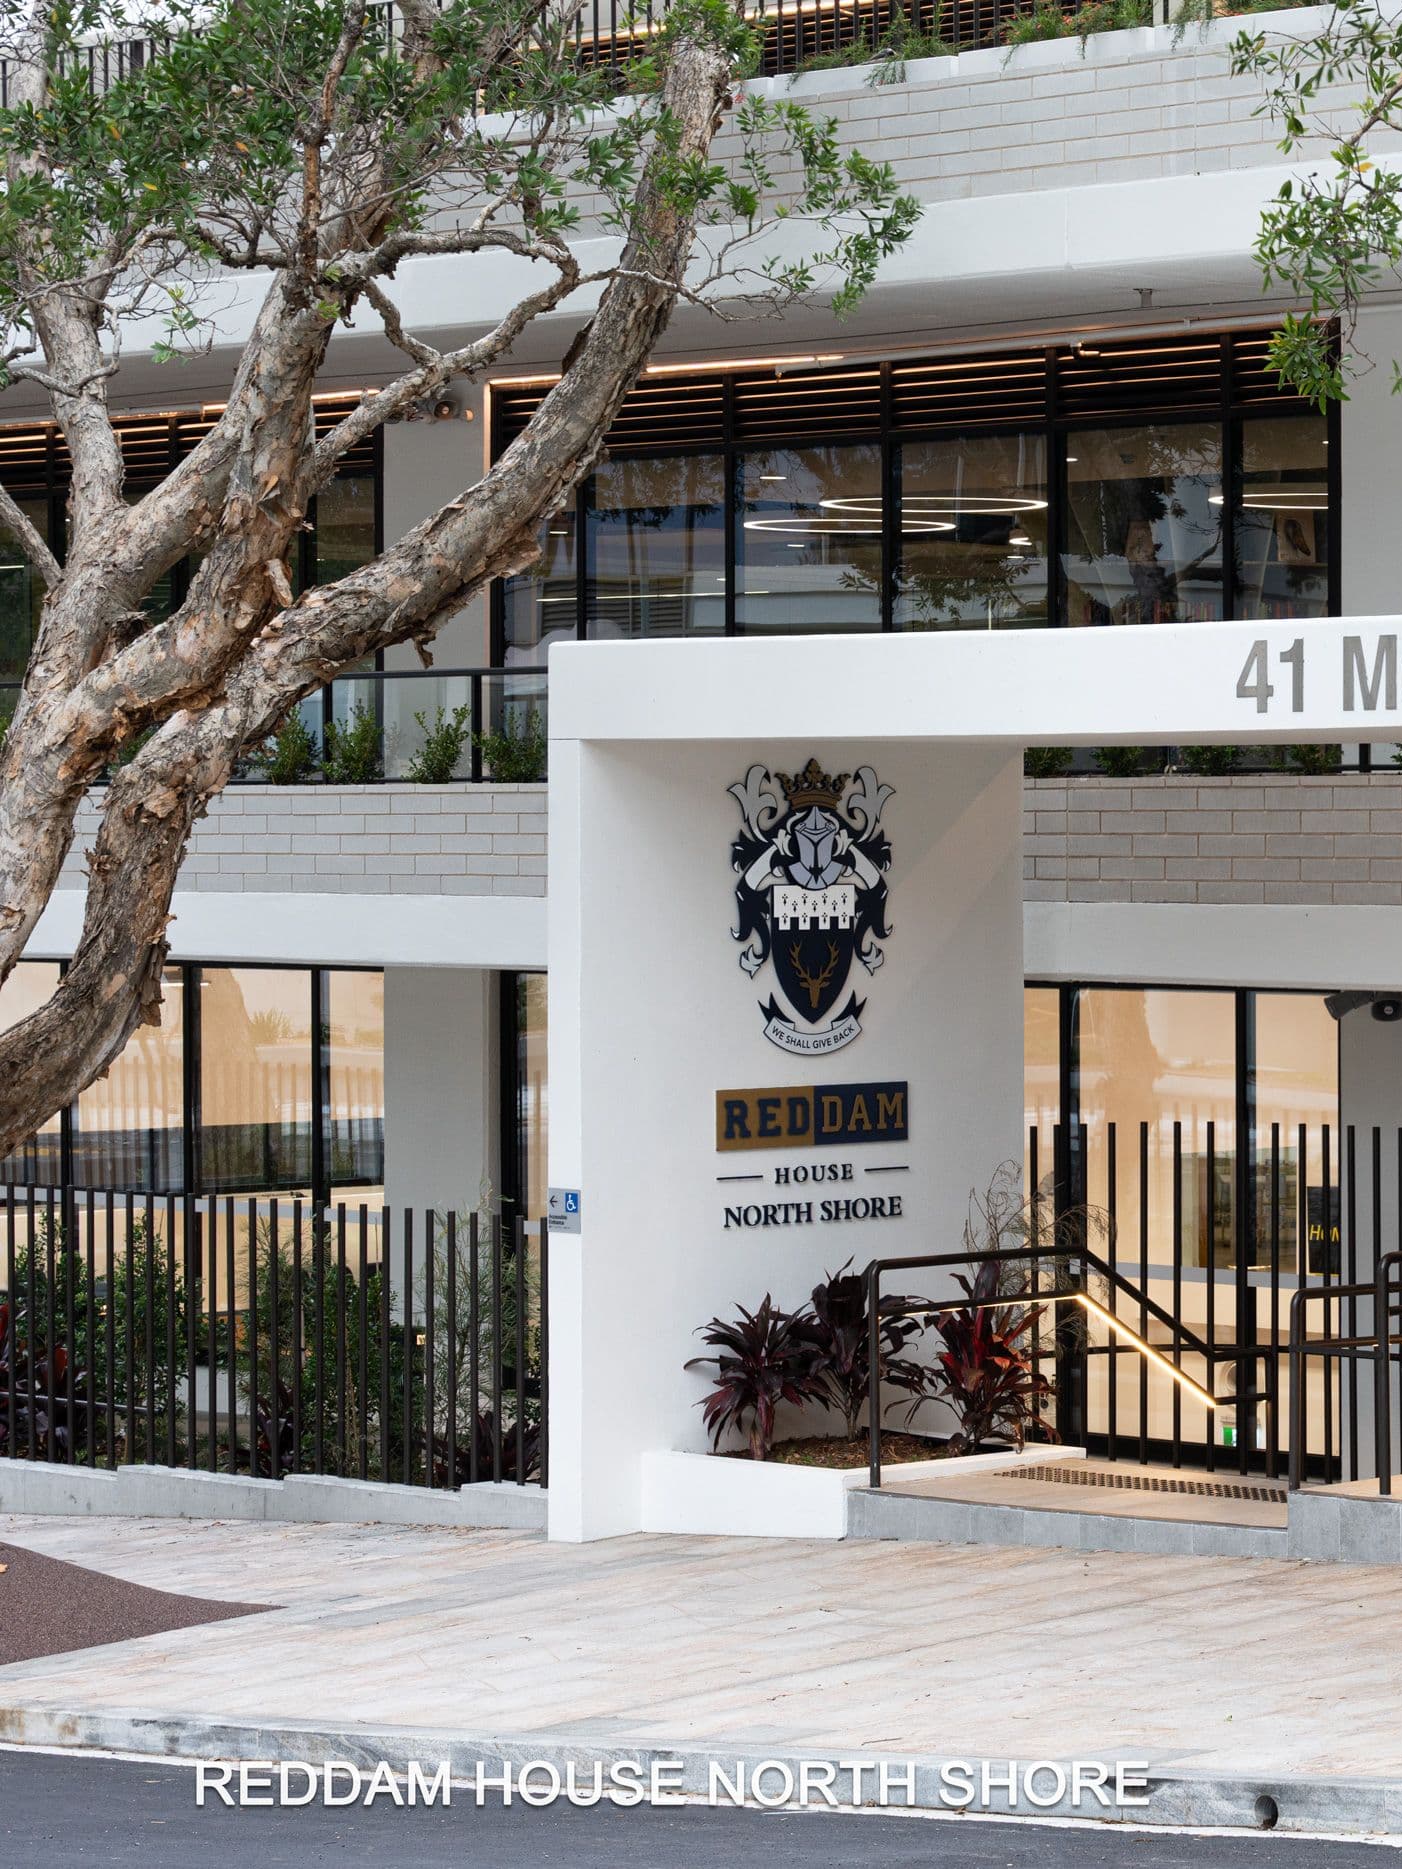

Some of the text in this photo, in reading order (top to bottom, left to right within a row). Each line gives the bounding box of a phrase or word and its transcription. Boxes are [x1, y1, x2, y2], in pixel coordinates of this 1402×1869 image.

[1236, 637, 1304, 713] 41
[771, 1024, 855, 1049] WE SHALL GIVE BACK
[723, 1092, 905, 1140] REDDAM
[774, 1163, 854, 1185] HOUSE
[723, 1195, 903, 1229] NORTH SHORE
